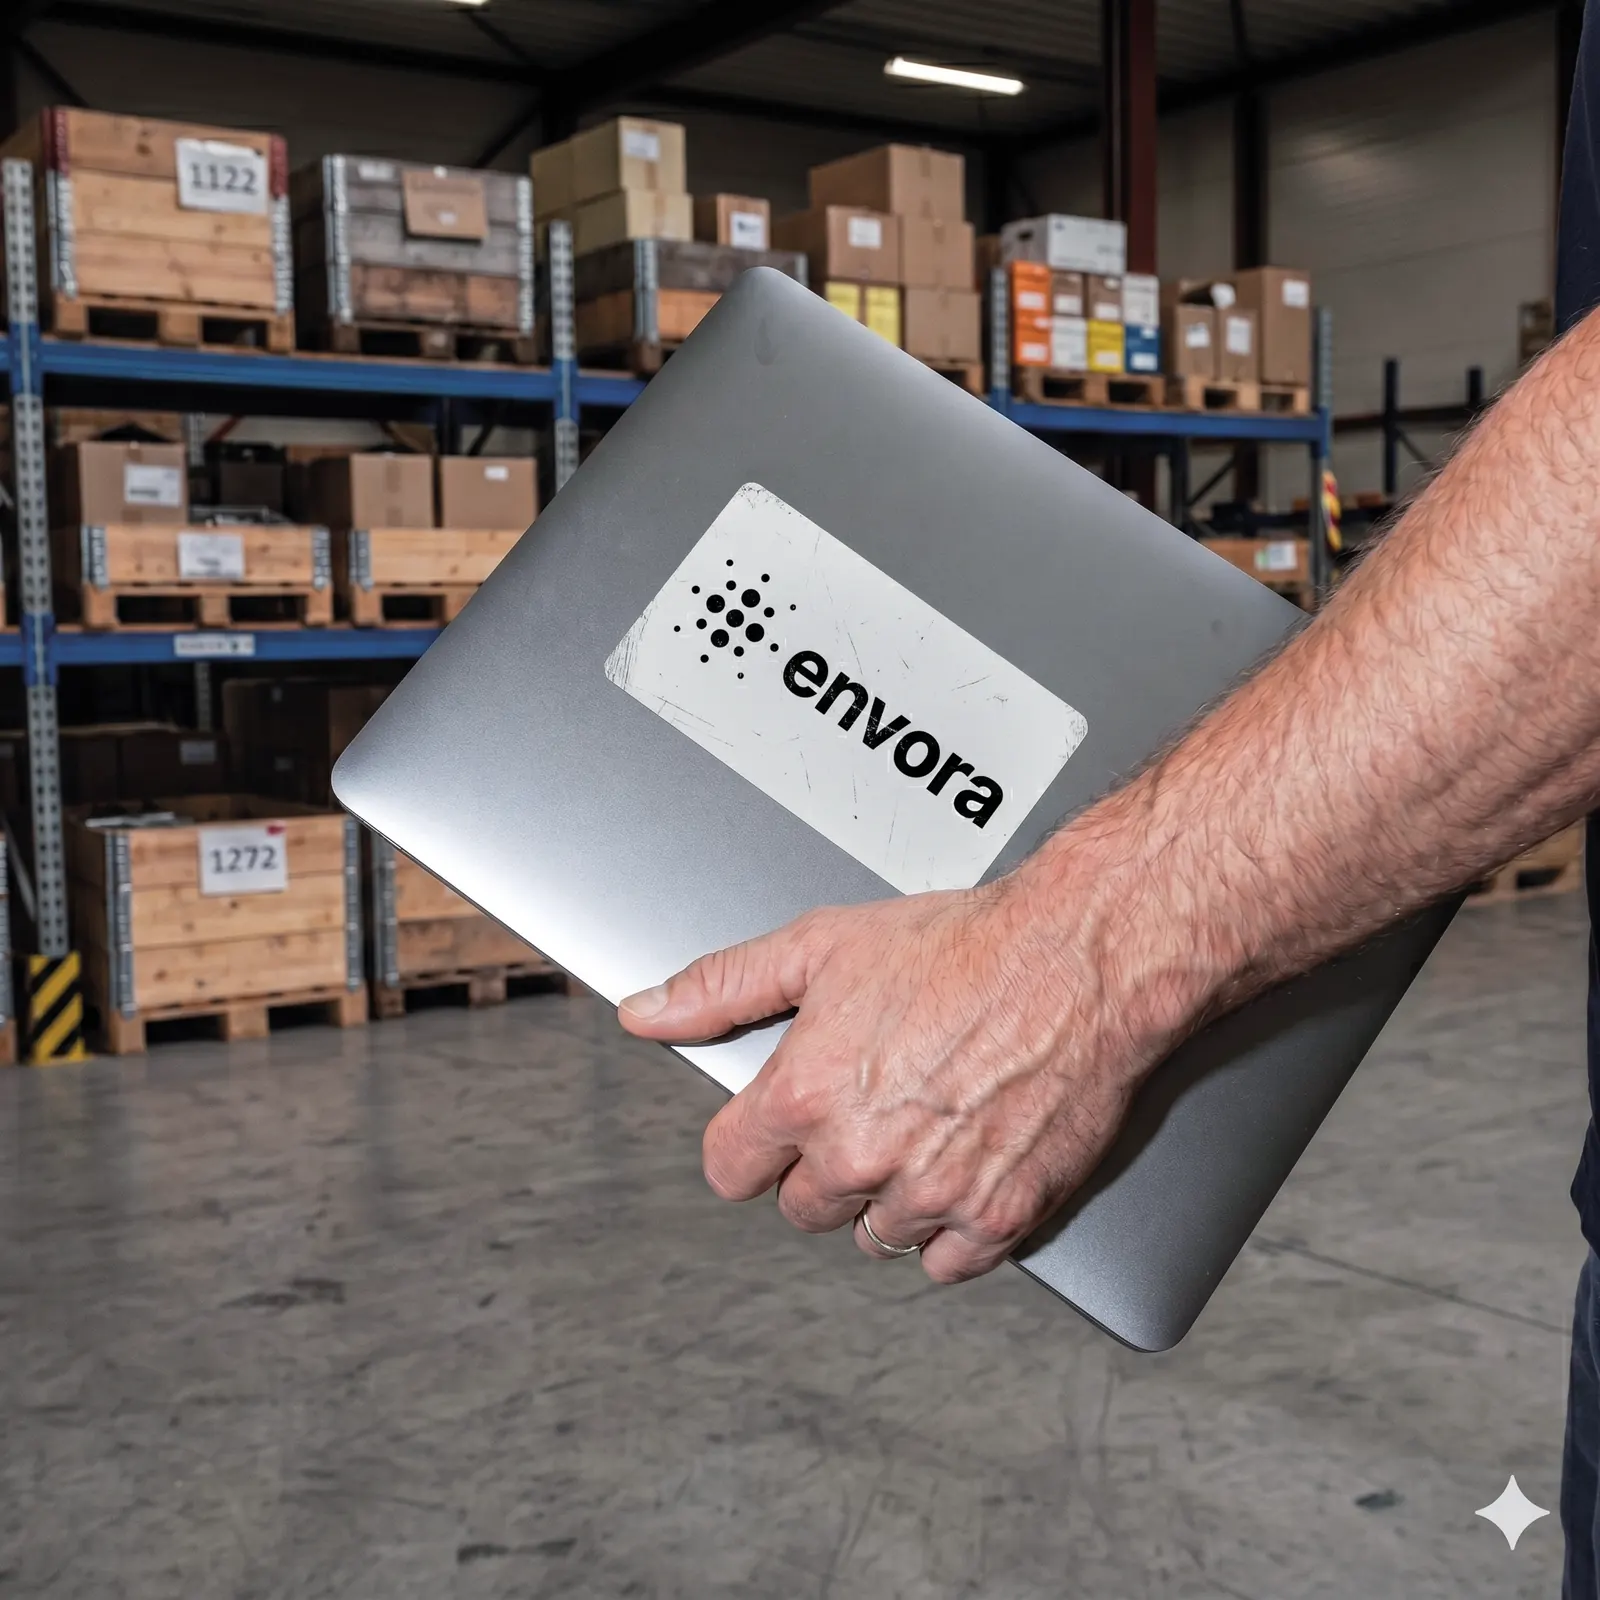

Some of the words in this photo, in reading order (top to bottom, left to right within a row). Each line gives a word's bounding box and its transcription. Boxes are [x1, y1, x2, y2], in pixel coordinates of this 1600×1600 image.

[190, 163, 258, 195] 1122
[782, 650, 1004, 829] envora
[210, 845, 278, 874] 1272
